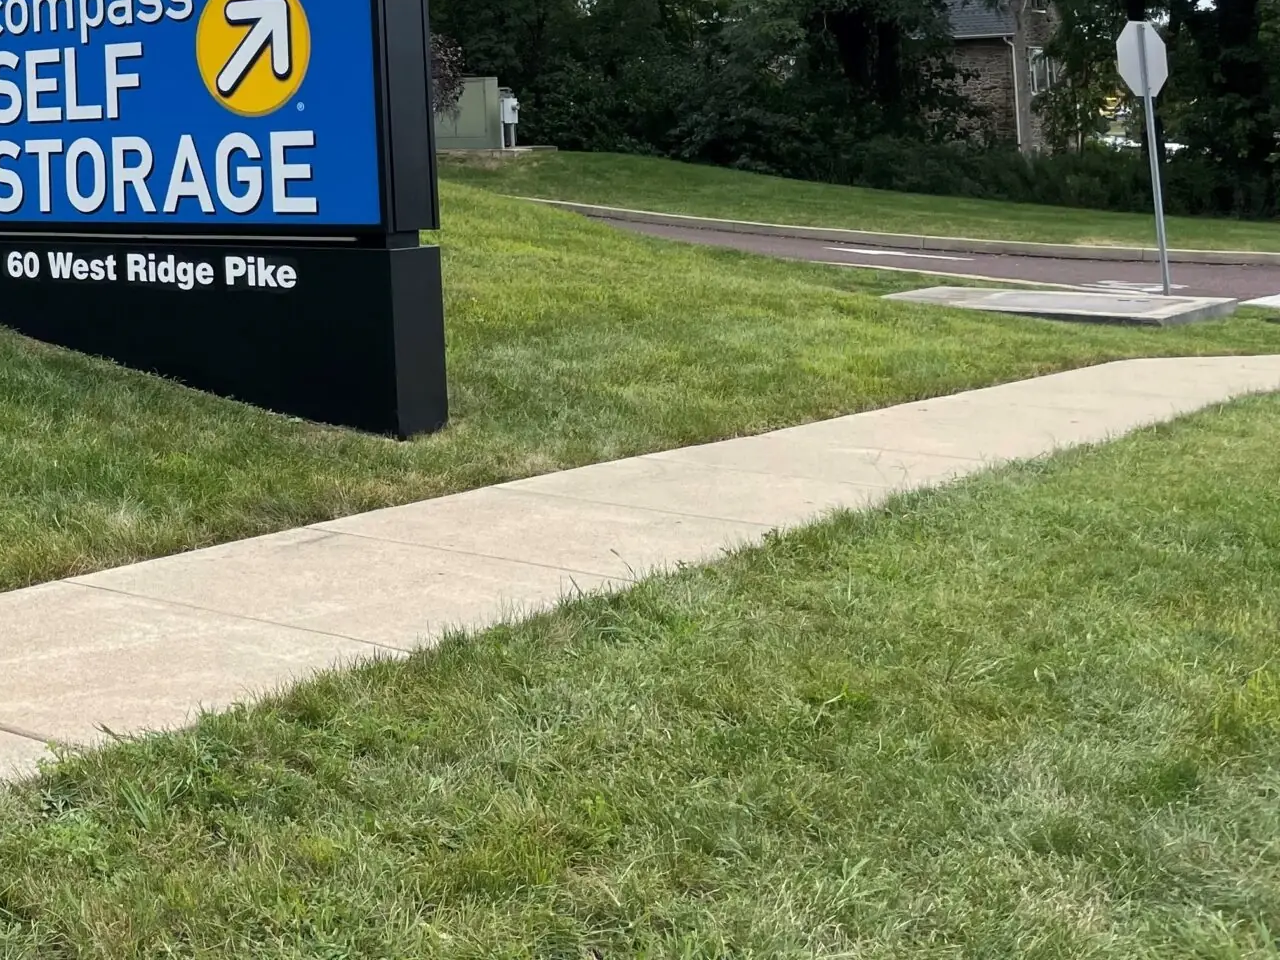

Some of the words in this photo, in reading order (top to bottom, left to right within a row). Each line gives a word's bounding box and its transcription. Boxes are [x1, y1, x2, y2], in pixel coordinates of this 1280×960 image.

[7, 251, 40, 278] 60
[47, 252, 117, 281] West
[127, 254, 214, 290] Ridge
[225, 256, 297, 288] Pike
